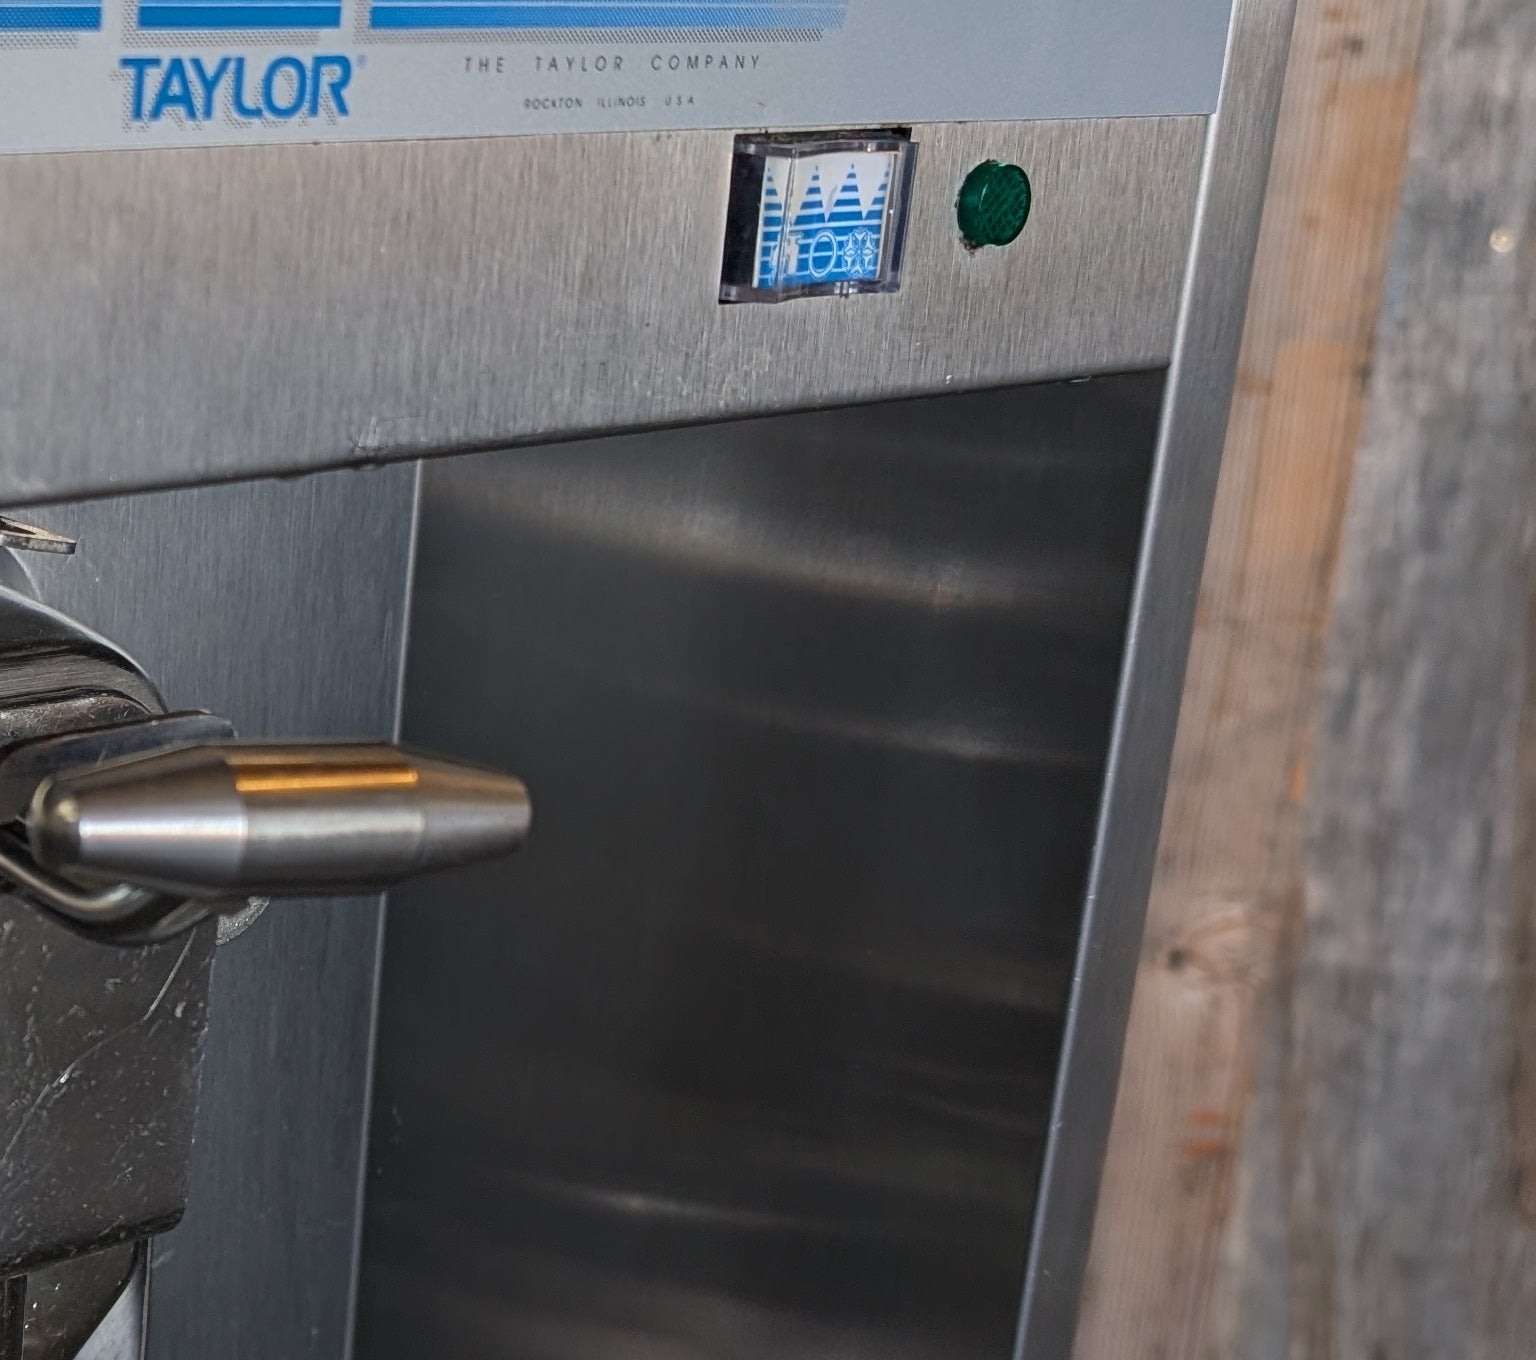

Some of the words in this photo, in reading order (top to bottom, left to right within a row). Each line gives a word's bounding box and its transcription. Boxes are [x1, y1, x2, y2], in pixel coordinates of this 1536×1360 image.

[464, 55, 505, 74] THE
[534, 55, 624, 72] TAYLOR
[650, 54, 760, 71] COMPANY
[119, 54, 352, 122] TAYLOR
